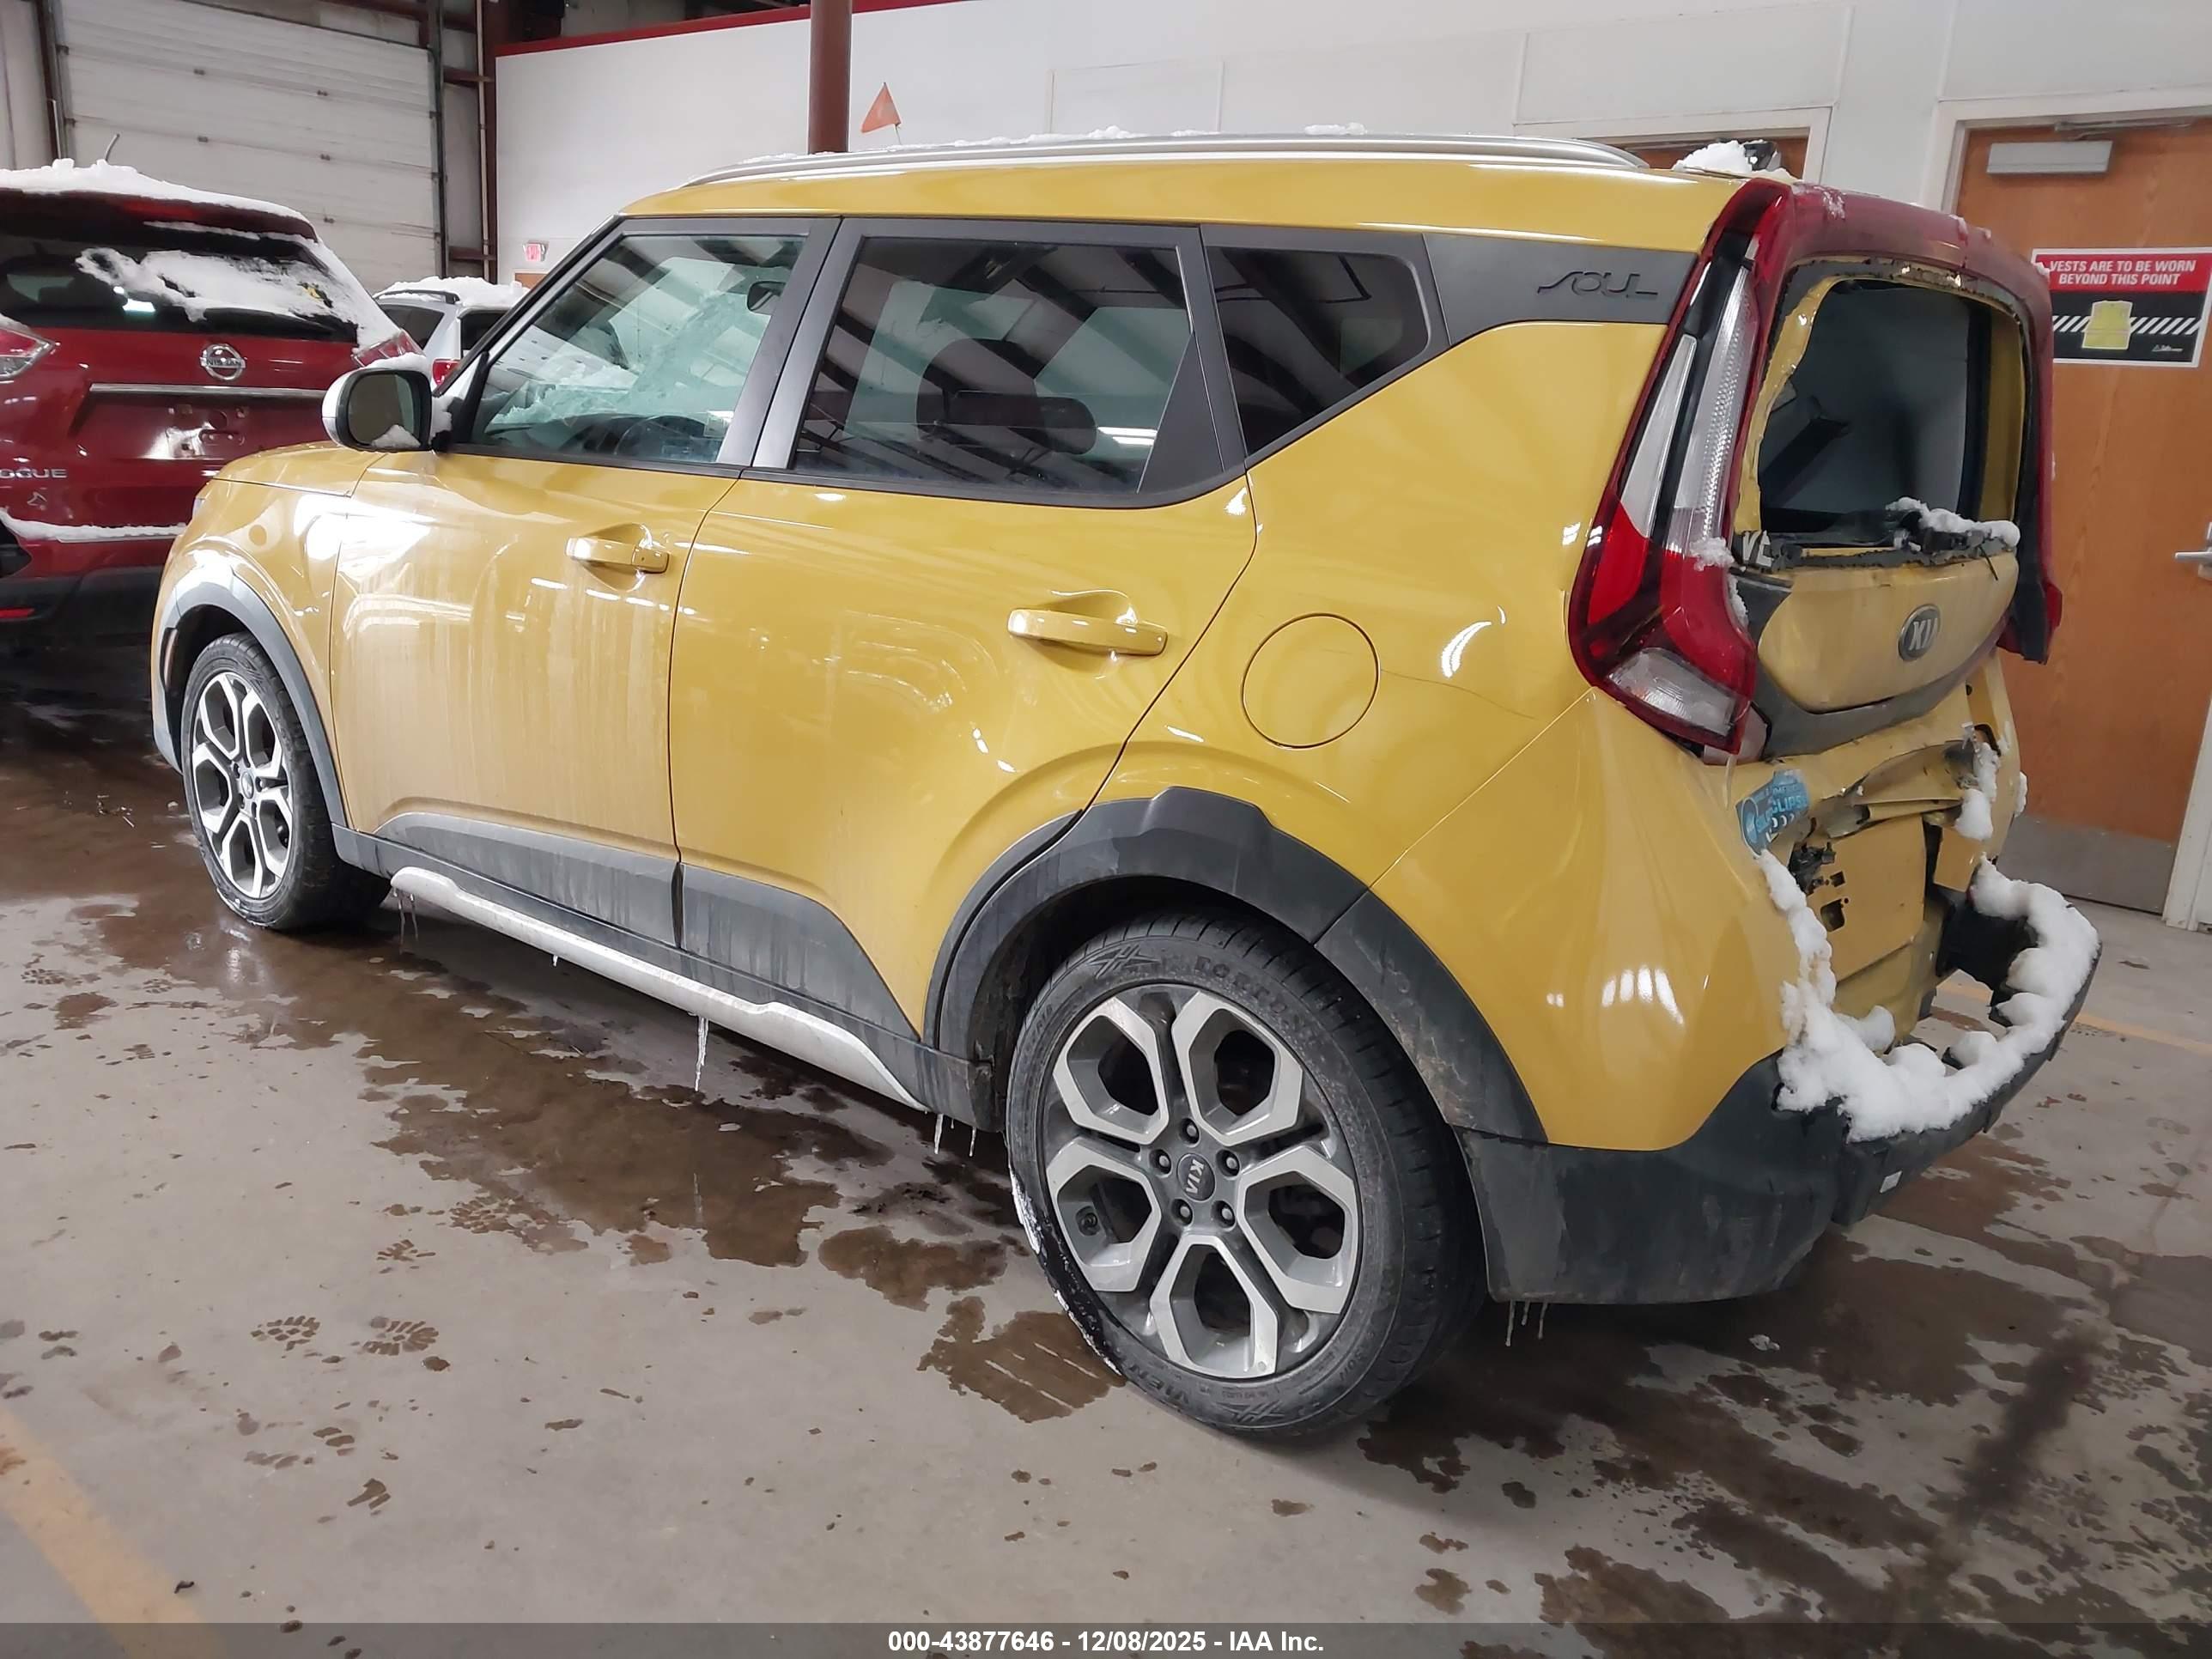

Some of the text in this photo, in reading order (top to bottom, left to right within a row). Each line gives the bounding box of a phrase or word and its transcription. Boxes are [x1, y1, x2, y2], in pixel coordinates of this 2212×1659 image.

[2050, 260, 2197, 272] VESTS ARE TO BE WORN
[1537, 271, 1658, 298] SOUL
[2058, 274, 2180, 285] BEYOND THIS POINT
[1186, 1158, 1204, 1194] KIA
